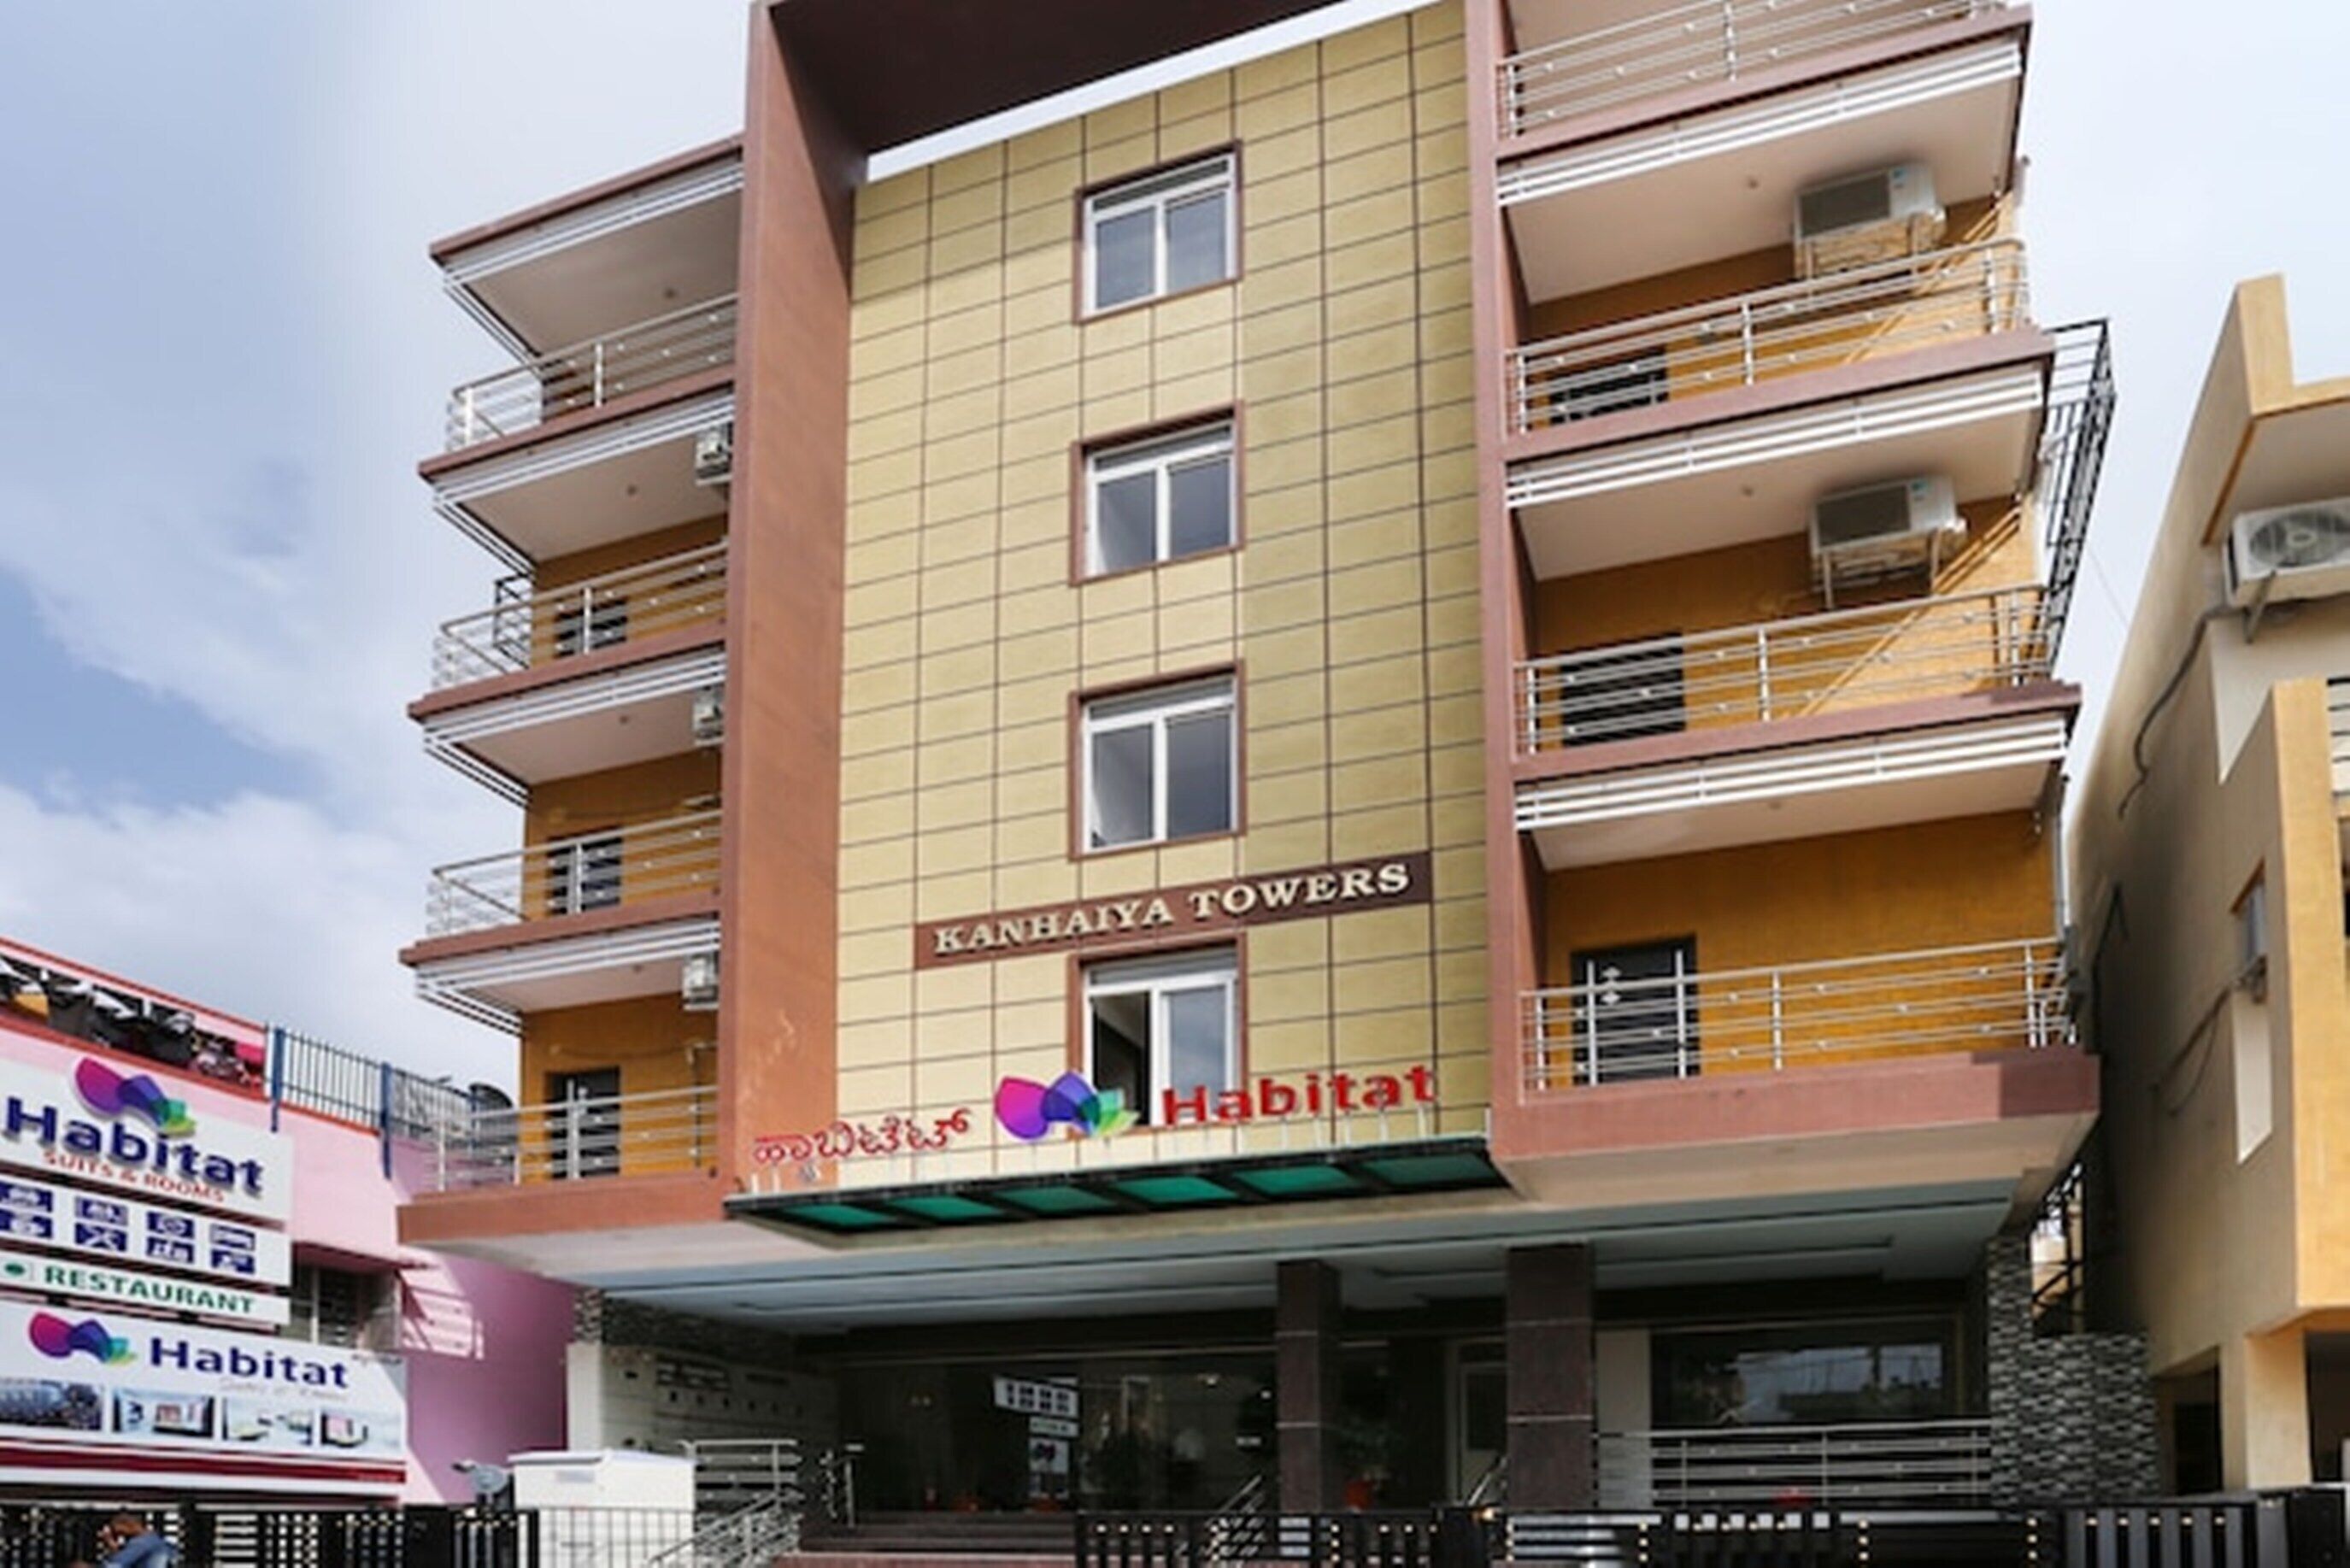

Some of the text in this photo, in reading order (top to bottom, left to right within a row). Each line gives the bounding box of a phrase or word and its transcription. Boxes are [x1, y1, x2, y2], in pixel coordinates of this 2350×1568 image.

[934, 863, 1411, 954] KANHAIYA TOWERS
[1162, 1065, 1436, 1126] Habitat
[6, 1095, 264, 1196] Habitat
[144, 1172, 225, 1202] ROOMS
[45, 1266, 255, 1313] RESTAURANT
[150, 1337, 349, 1389] Habitat
